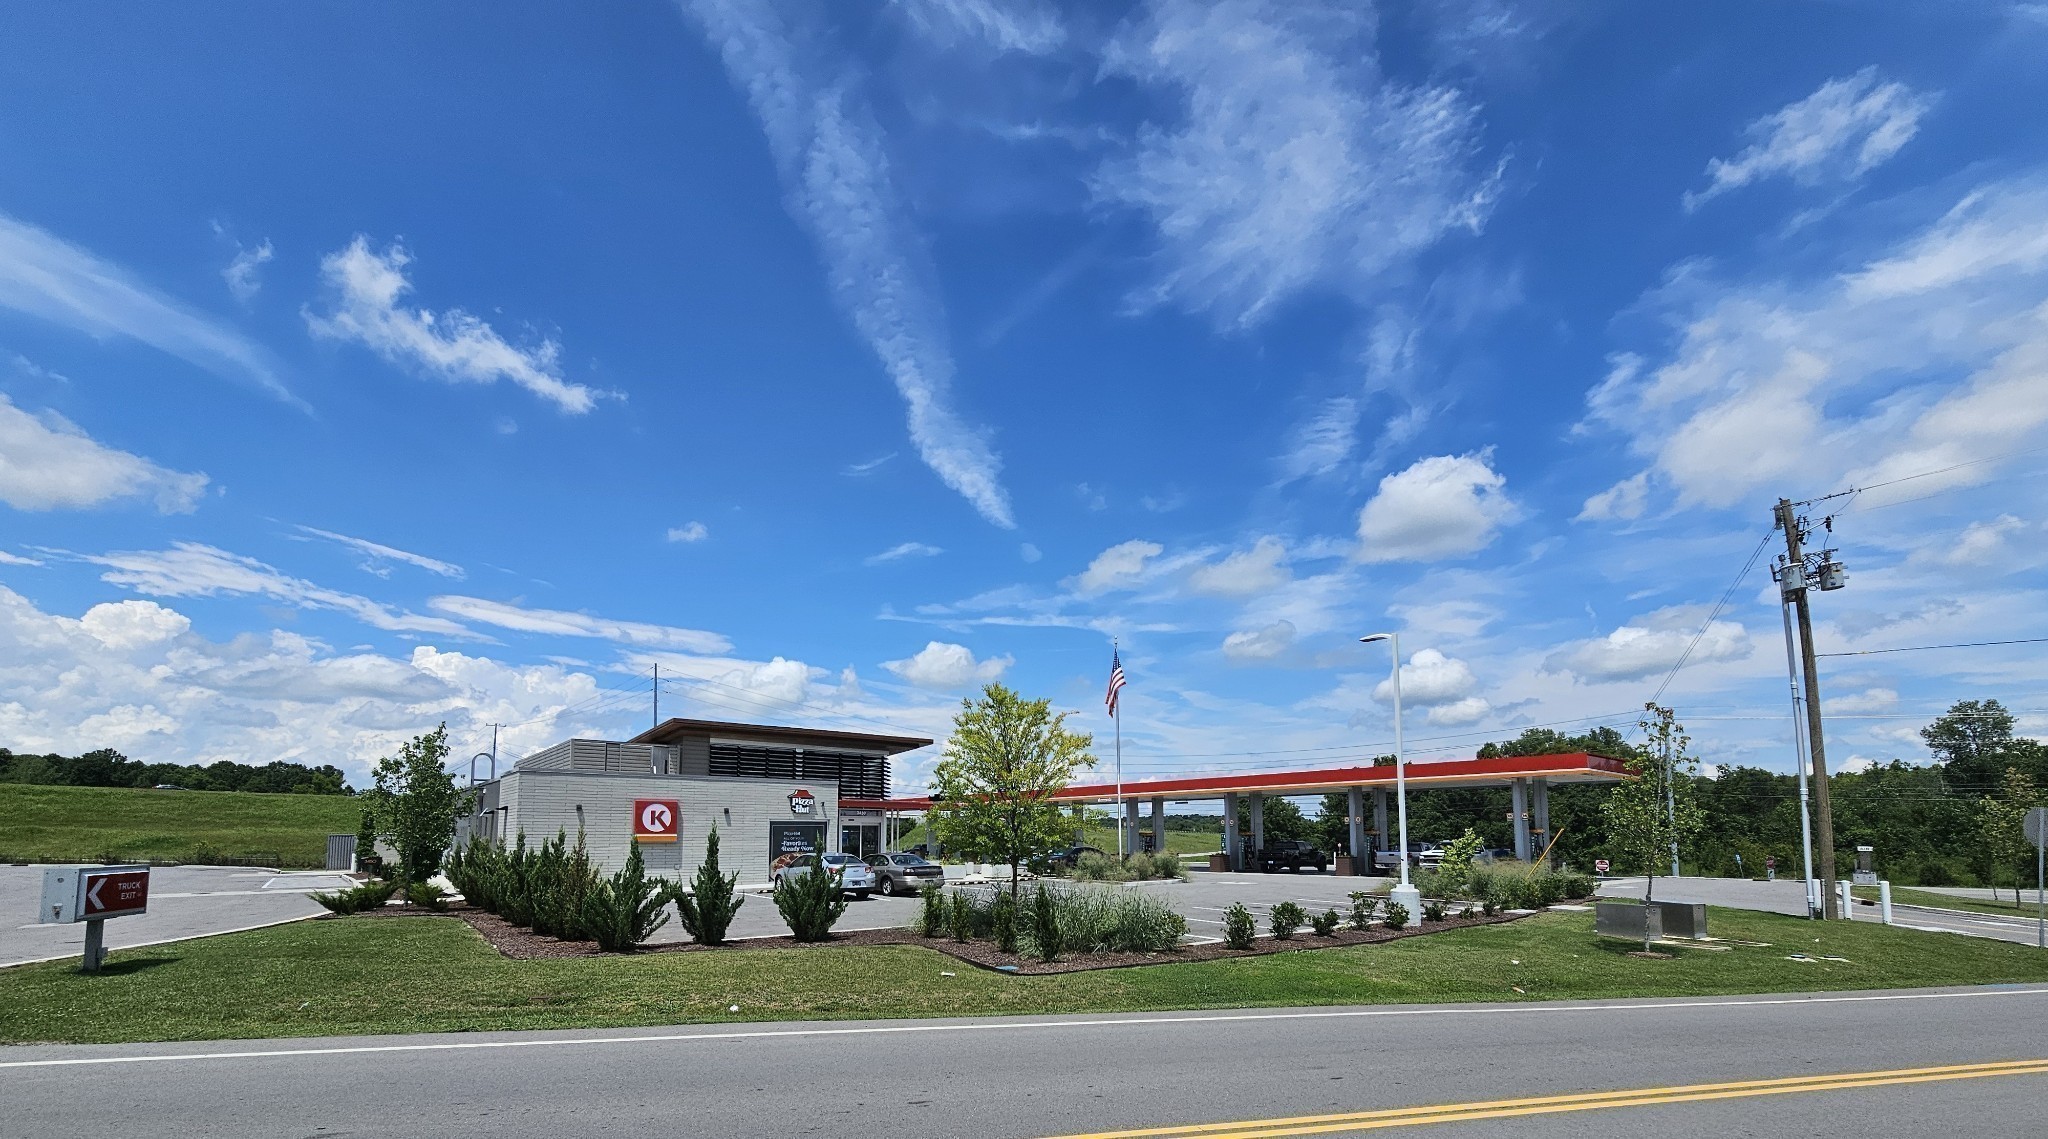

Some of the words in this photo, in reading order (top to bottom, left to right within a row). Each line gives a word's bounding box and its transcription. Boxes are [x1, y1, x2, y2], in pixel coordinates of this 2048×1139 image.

[791, 797, 814, 806] Pizza
[792, 804, 810, 814] Hut
[117, 881, 141, 890] TRUCK
[120, 891, 137, 900] EXIT
